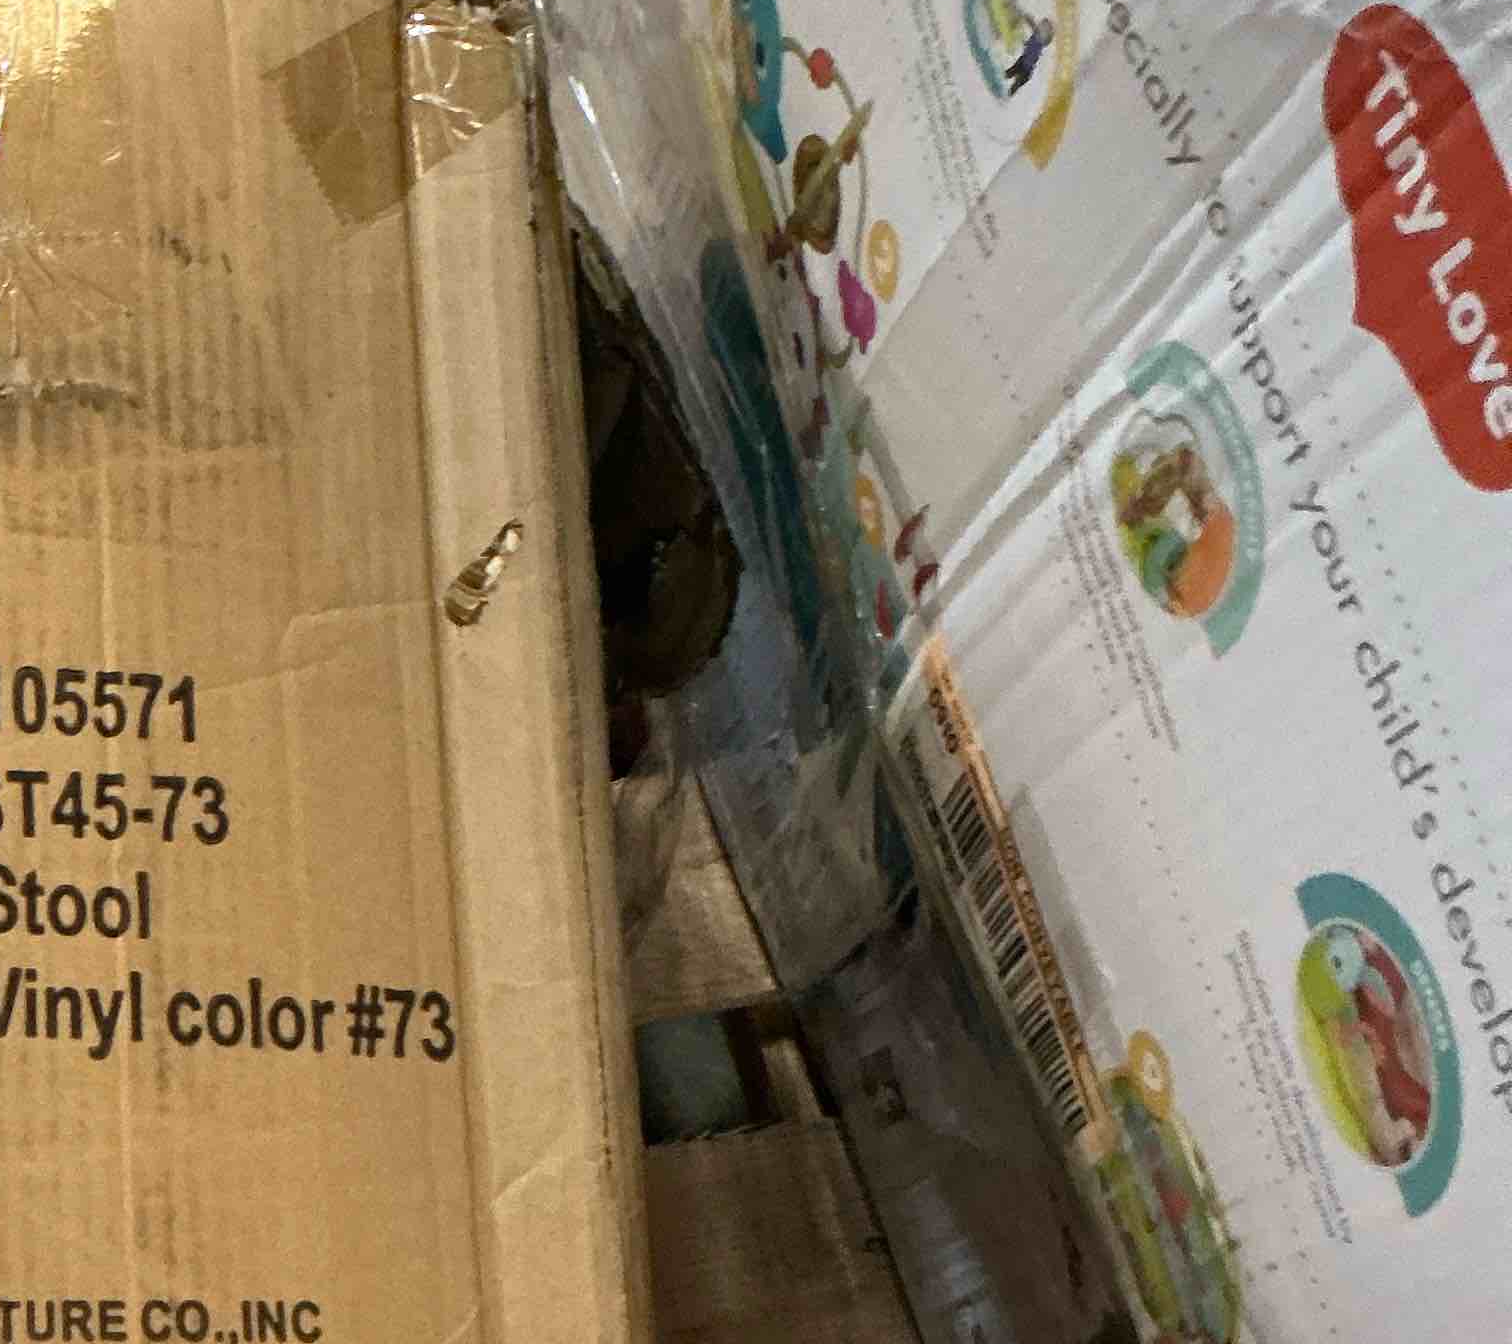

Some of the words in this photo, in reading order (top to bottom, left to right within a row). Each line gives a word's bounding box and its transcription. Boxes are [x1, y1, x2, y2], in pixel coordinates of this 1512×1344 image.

[1364, 49, 1449, 235] Tiny
[1427, 237, 1512, 441] Love
[1289, 480, 1363, 612] your
[1355, 641, 1440, 840] child's
[167, 979, 334, 1053] color
[347, 985, 456, 1063] #73
